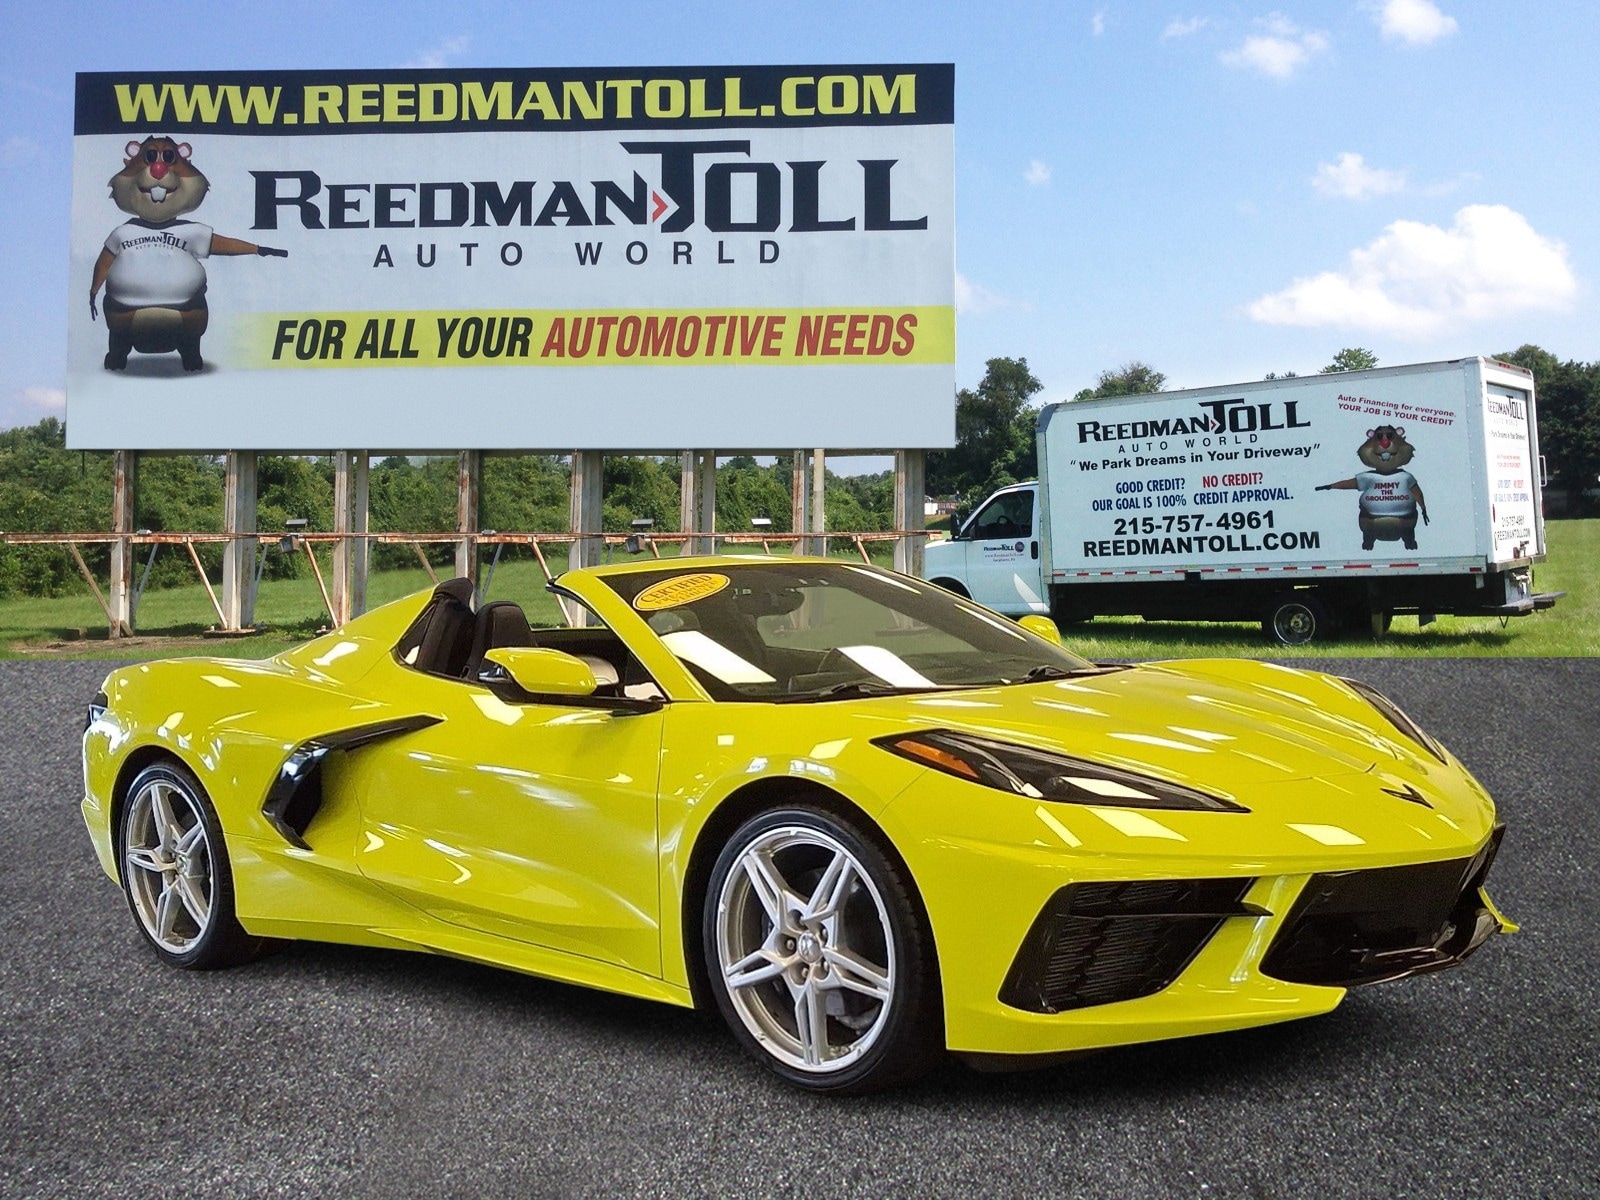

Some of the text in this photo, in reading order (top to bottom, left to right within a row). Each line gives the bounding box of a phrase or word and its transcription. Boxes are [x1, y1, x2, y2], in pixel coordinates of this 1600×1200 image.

[114, 74, 916, 125] WWW.REEDMANTOLL.COM
[373, 240, 780, 268] AUTO WORLD
[272, 314, 918, 360] FOR ALL YOUR AUTOMOTIVE NEEDS
[1337, 394, 1457, 418] Auto Financing for everyone.
[1338, 403, 1361, 412] YOUR
[1363, 406, 1380, 415] JOB
[1394, 411, 1418, 421] YOUR
[1421, 415, 1454, 426] CREDIT
[1118, 433, 1258, 453] AUTO WORLD
[1102, 458, 1131, 469] Park
[1136, 455, 1186, 467] Dreams
[1191, 453, 1203, 462] in
[1207, 450, 1239, 460] Your
[1116, 472, 1263, 494] GOOD CREDIT? NO CREDIT?
[1092, 487, 1294, 511] OUR GOAL IS 100% CREDIT APPROVAL.
[1114, 510, 1274, 536] 215-757-4961
[1083, 531, 1320, 557] REEDMANTOLL.COM
[641, 575, 712, 602] CERTIFIED
